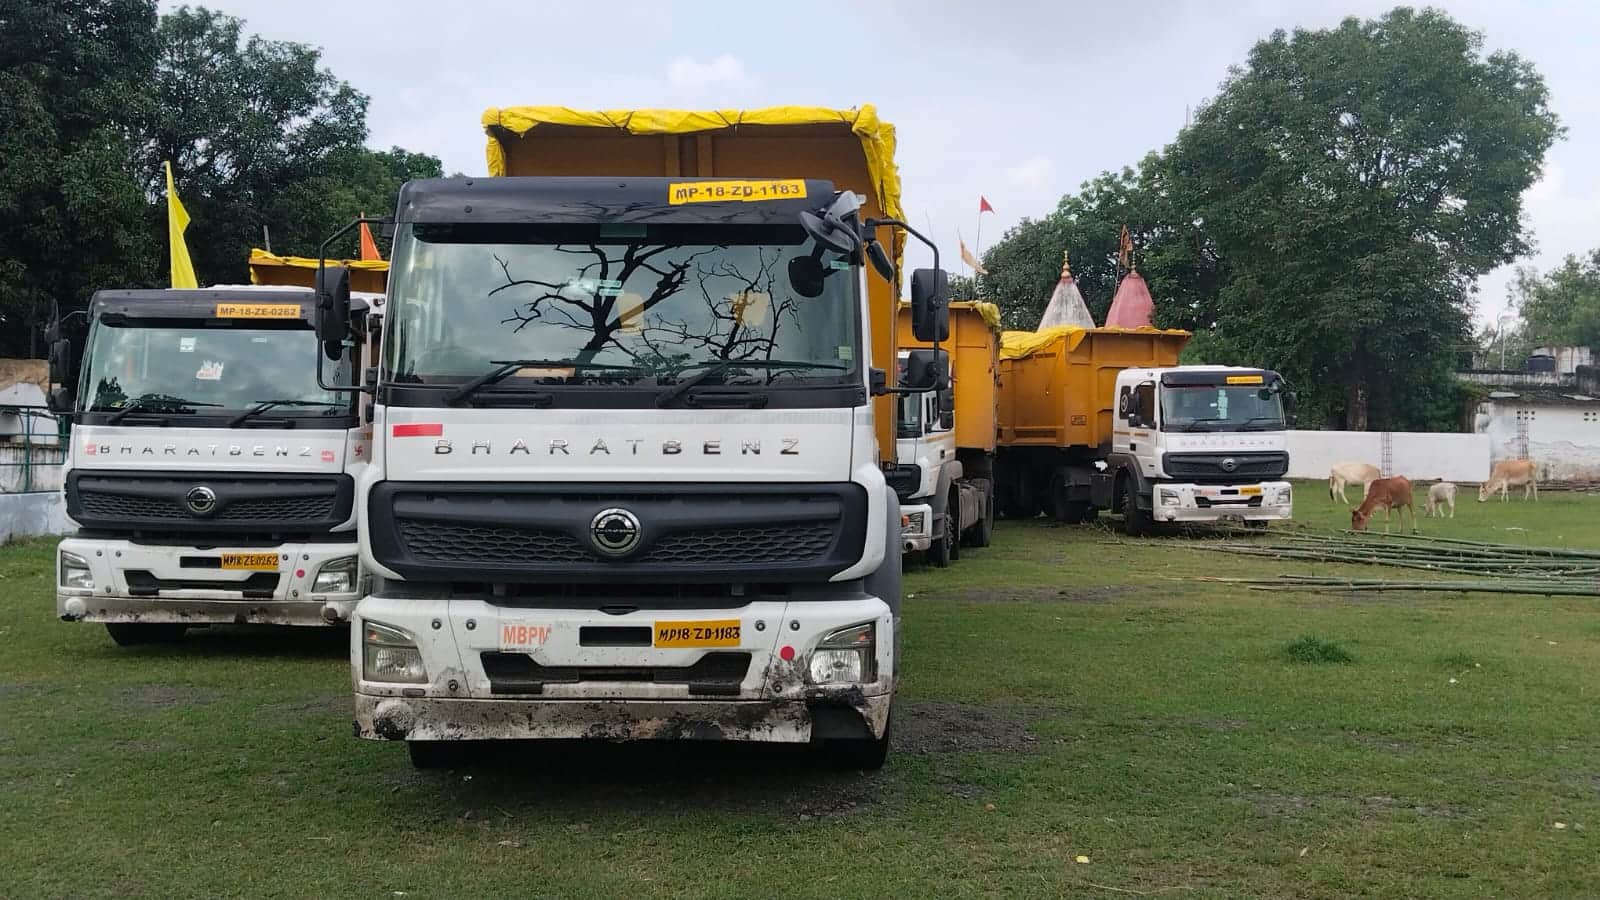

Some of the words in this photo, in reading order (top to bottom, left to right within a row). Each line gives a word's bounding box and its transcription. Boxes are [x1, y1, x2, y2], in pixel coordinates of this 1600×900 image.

[675, 184, 800, 200] MP-18-ZD-1183
[99, 444, 312, 457] BHARATBENZ
[434, 438, 800, 455] BHARATBENZ
